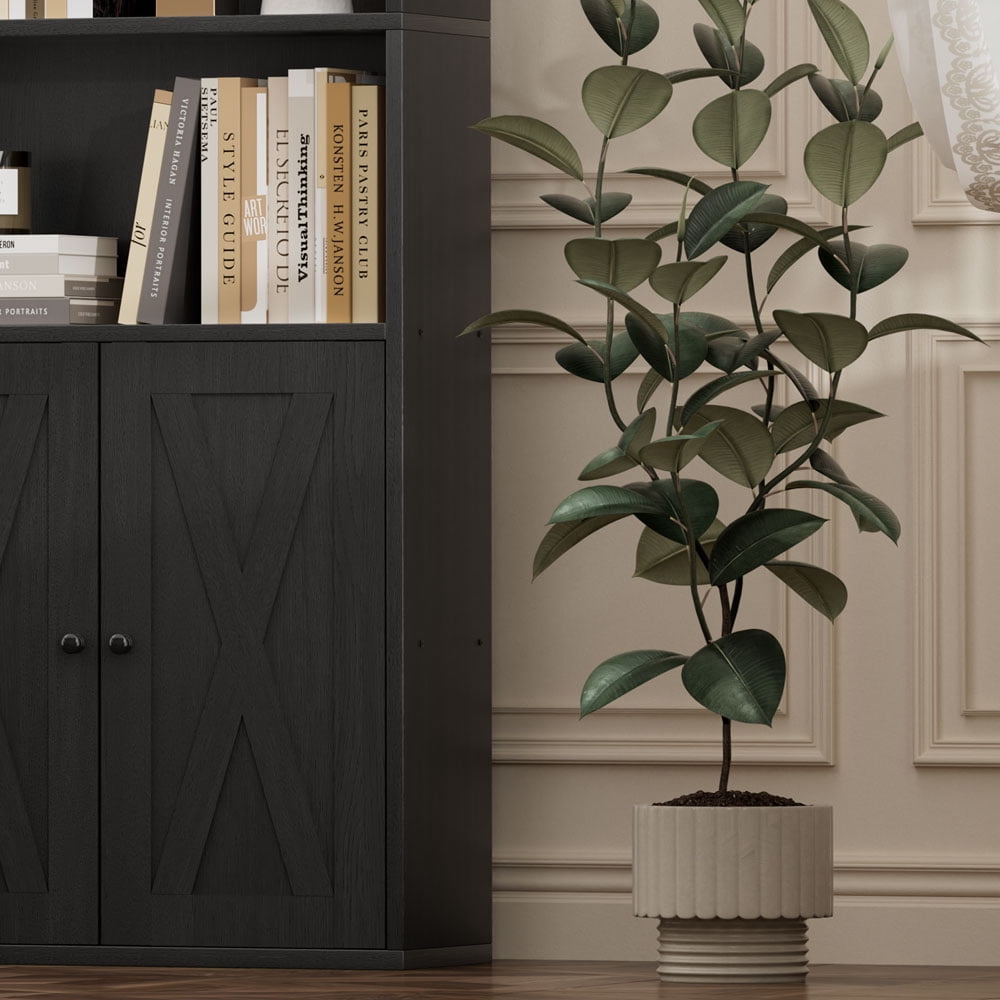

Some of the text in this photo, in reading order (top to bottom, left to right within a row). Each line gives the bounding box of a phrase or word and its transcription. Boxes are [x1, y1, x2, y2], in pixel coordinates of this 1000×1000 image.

[201, 87, 209, 163] SIETSEMA
[209, 87, 218, 127] PAUL
[149, 98, 190, 299] VICTORIA HAGAN INTERIOR PORTRAITS
[222, 132, 236, 286] STYLE GUIDE
[244, 198, 263, 218] ART
[297, 132, 311, 283] Visual Thinking
[331, 124, 344, 297] KONSTEN H.W.JANSON
[358, 109, 369, 280] PARIS PASTRY CLUB
[4, 306, 48, 316] PORTRAITS
